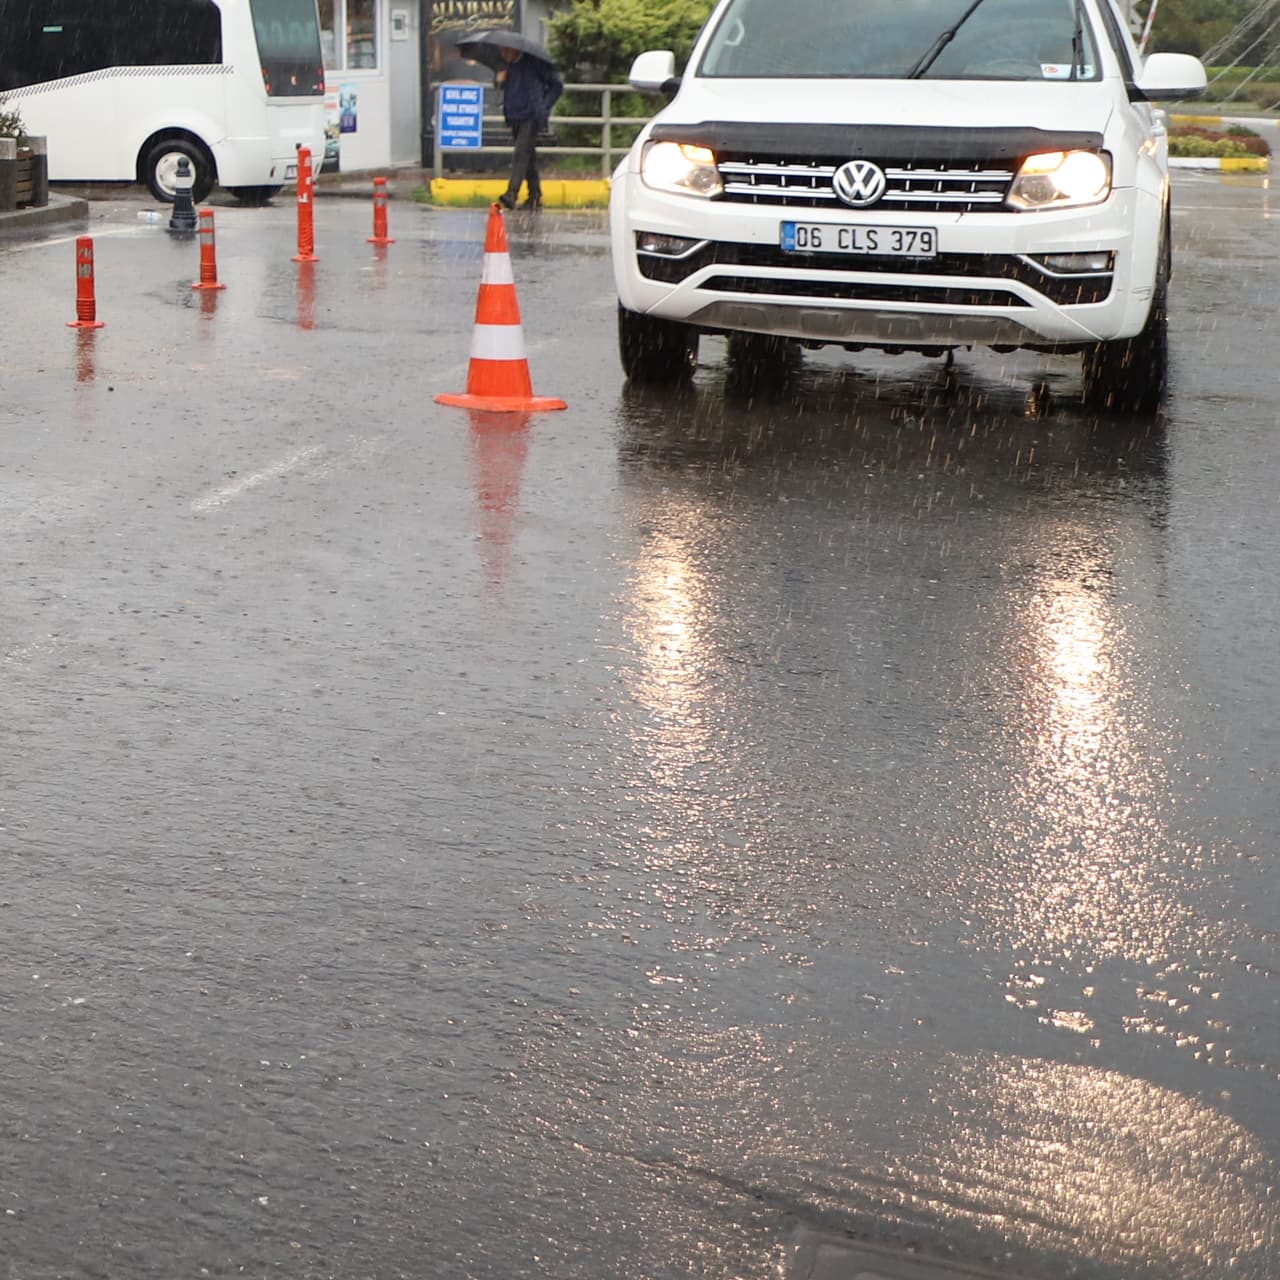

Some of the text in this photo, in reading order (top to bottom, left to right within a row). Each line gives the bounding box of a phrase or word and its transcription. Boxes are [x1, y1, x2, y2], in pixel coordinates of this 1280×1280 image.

[796, 227, 933, 253] 06 CLS 379
